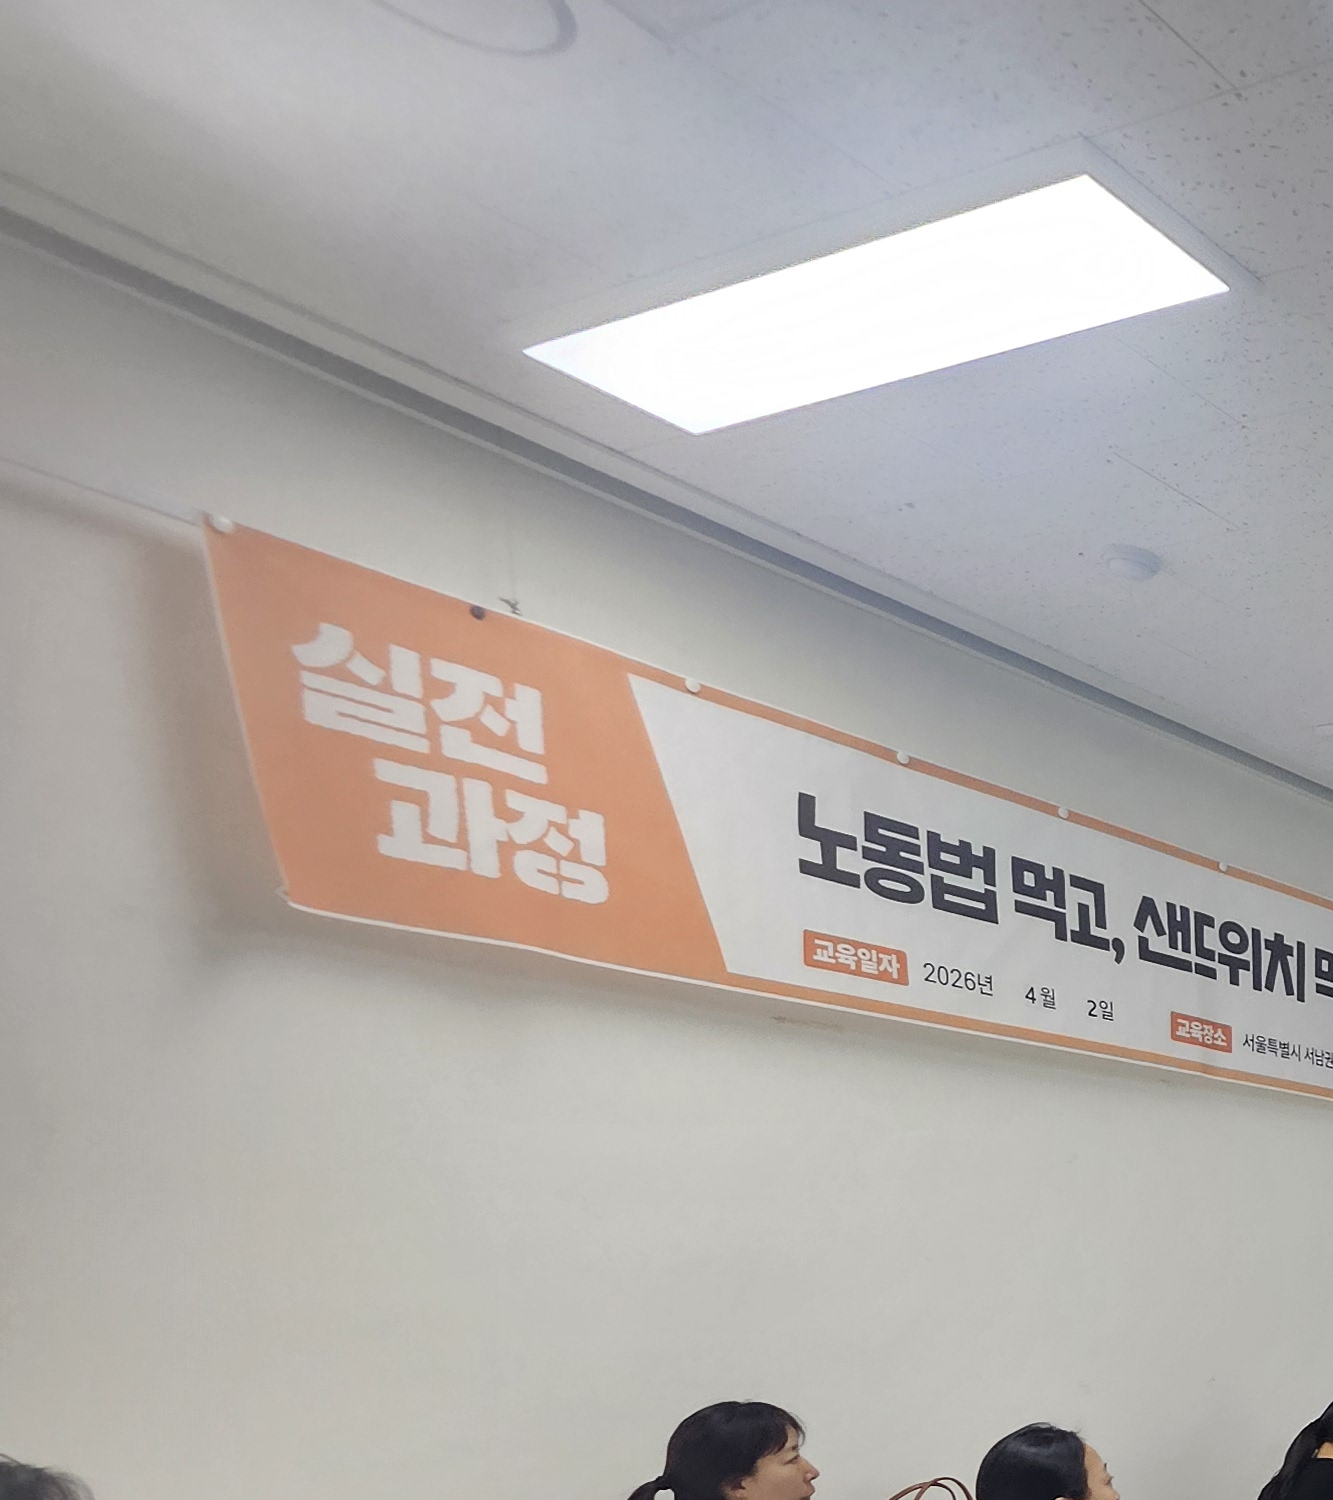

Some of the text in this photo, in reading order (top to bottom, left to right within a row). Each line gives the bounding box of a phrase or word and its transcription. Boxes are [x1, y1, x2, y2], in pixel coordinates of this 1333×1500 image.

[291, 622, 548, 785] 실전
[372, 758, 609, 904] 과정
[798, 791, 999, 925] 노동법
[1011, 855, 1125, 965] 먹고,
[1133, 895, 1306, 1003] 샌드위치
[812, 938, 900, 979] 교육일자
[922, 962, 994, 997] 2026년
[1087, 999, 1115, 1022] 2일
[1175, 1018, 1228, 1047] 교육장소
[1242, 1033, 1302, 1062] 서울특별시
